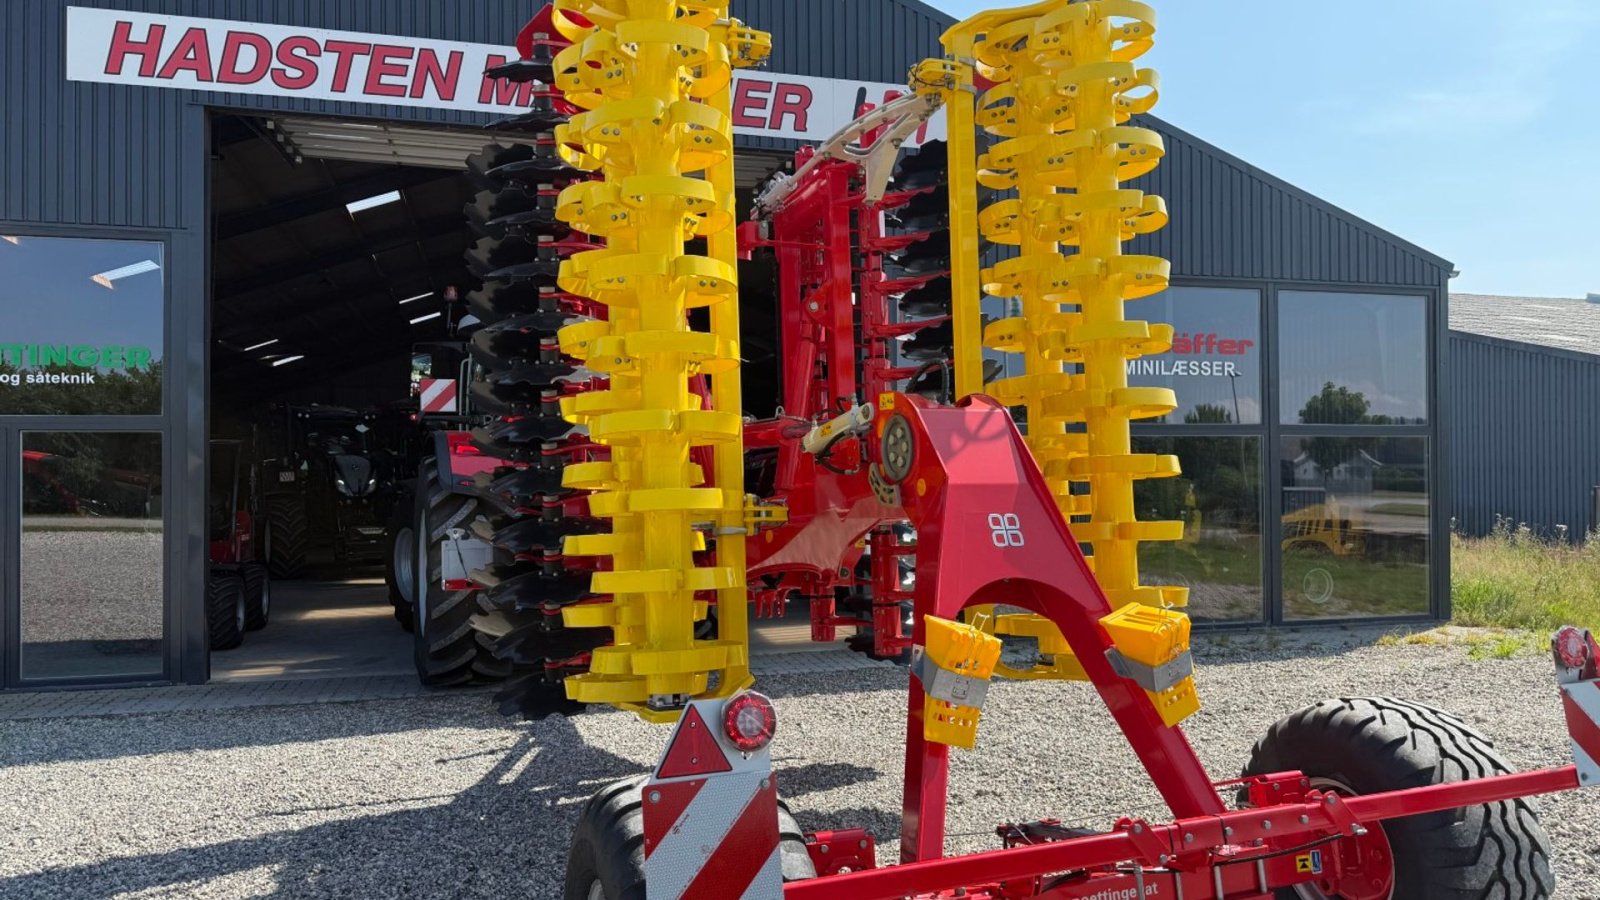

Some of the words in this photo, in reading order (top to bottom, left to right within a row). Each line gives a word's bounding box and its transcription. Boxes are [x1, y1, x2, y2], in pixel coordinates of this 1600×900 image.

[104, 20, 464, 101] HADSTEN
[1172, 332, 1254, 355] äffer
[1127, 359, 1236, 377] MINILÆSSER
[0, 373, 20, 386] og
[26, 371, 95, 384] såteknik
